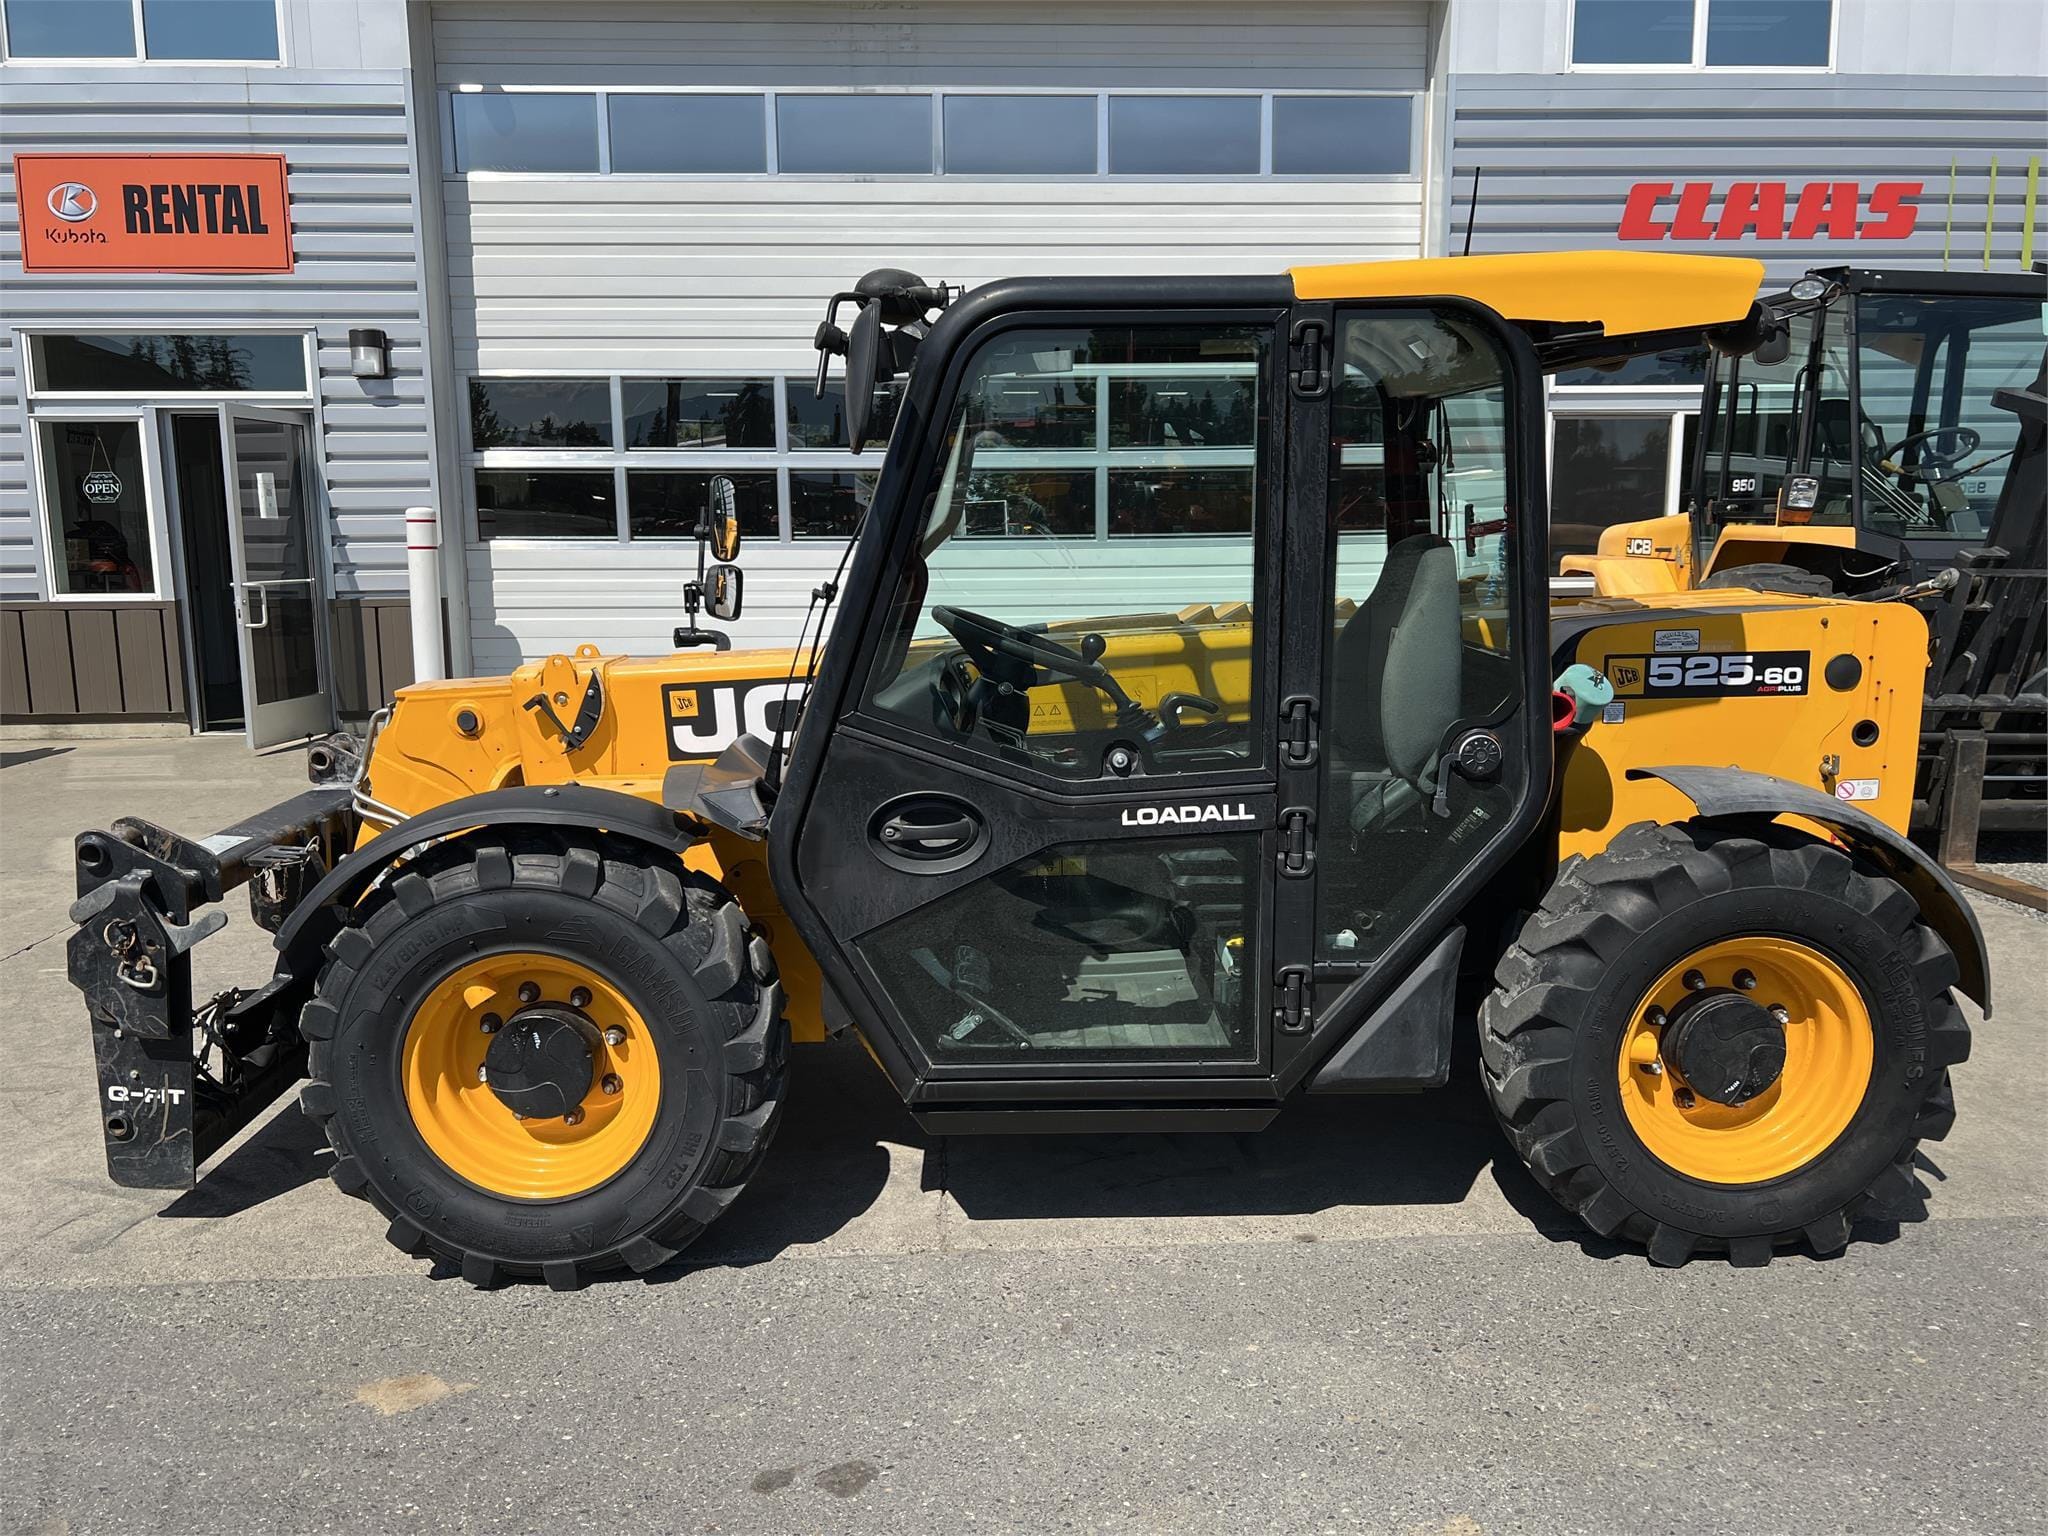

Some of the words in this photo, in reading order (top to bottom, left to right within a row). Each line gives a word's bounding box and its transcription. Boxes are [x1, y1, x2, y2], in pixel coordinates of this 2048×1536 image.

[122, 184, 269, 234] RENTAL
[1618, 182, 1924, 240] CLAAS
[45, 228, 108, 244] Kubota
[85, 483, 120, 494] OPEN
[1732, 478, 1756, 492] 950
[1626, 538, 1652, 555] JCB
[1616, 668, 1639, 686] JCB
[1648, 655, 1803, 688] 525-60
[676, 696, 694, 710] JCB
[673, 683, 813, 753] JC
[1121, 803, 1256, 826] LOADALL
[608, 934, 701, 1037] CAMSO
[1880, 949, 1926, 1080] HERCULES
